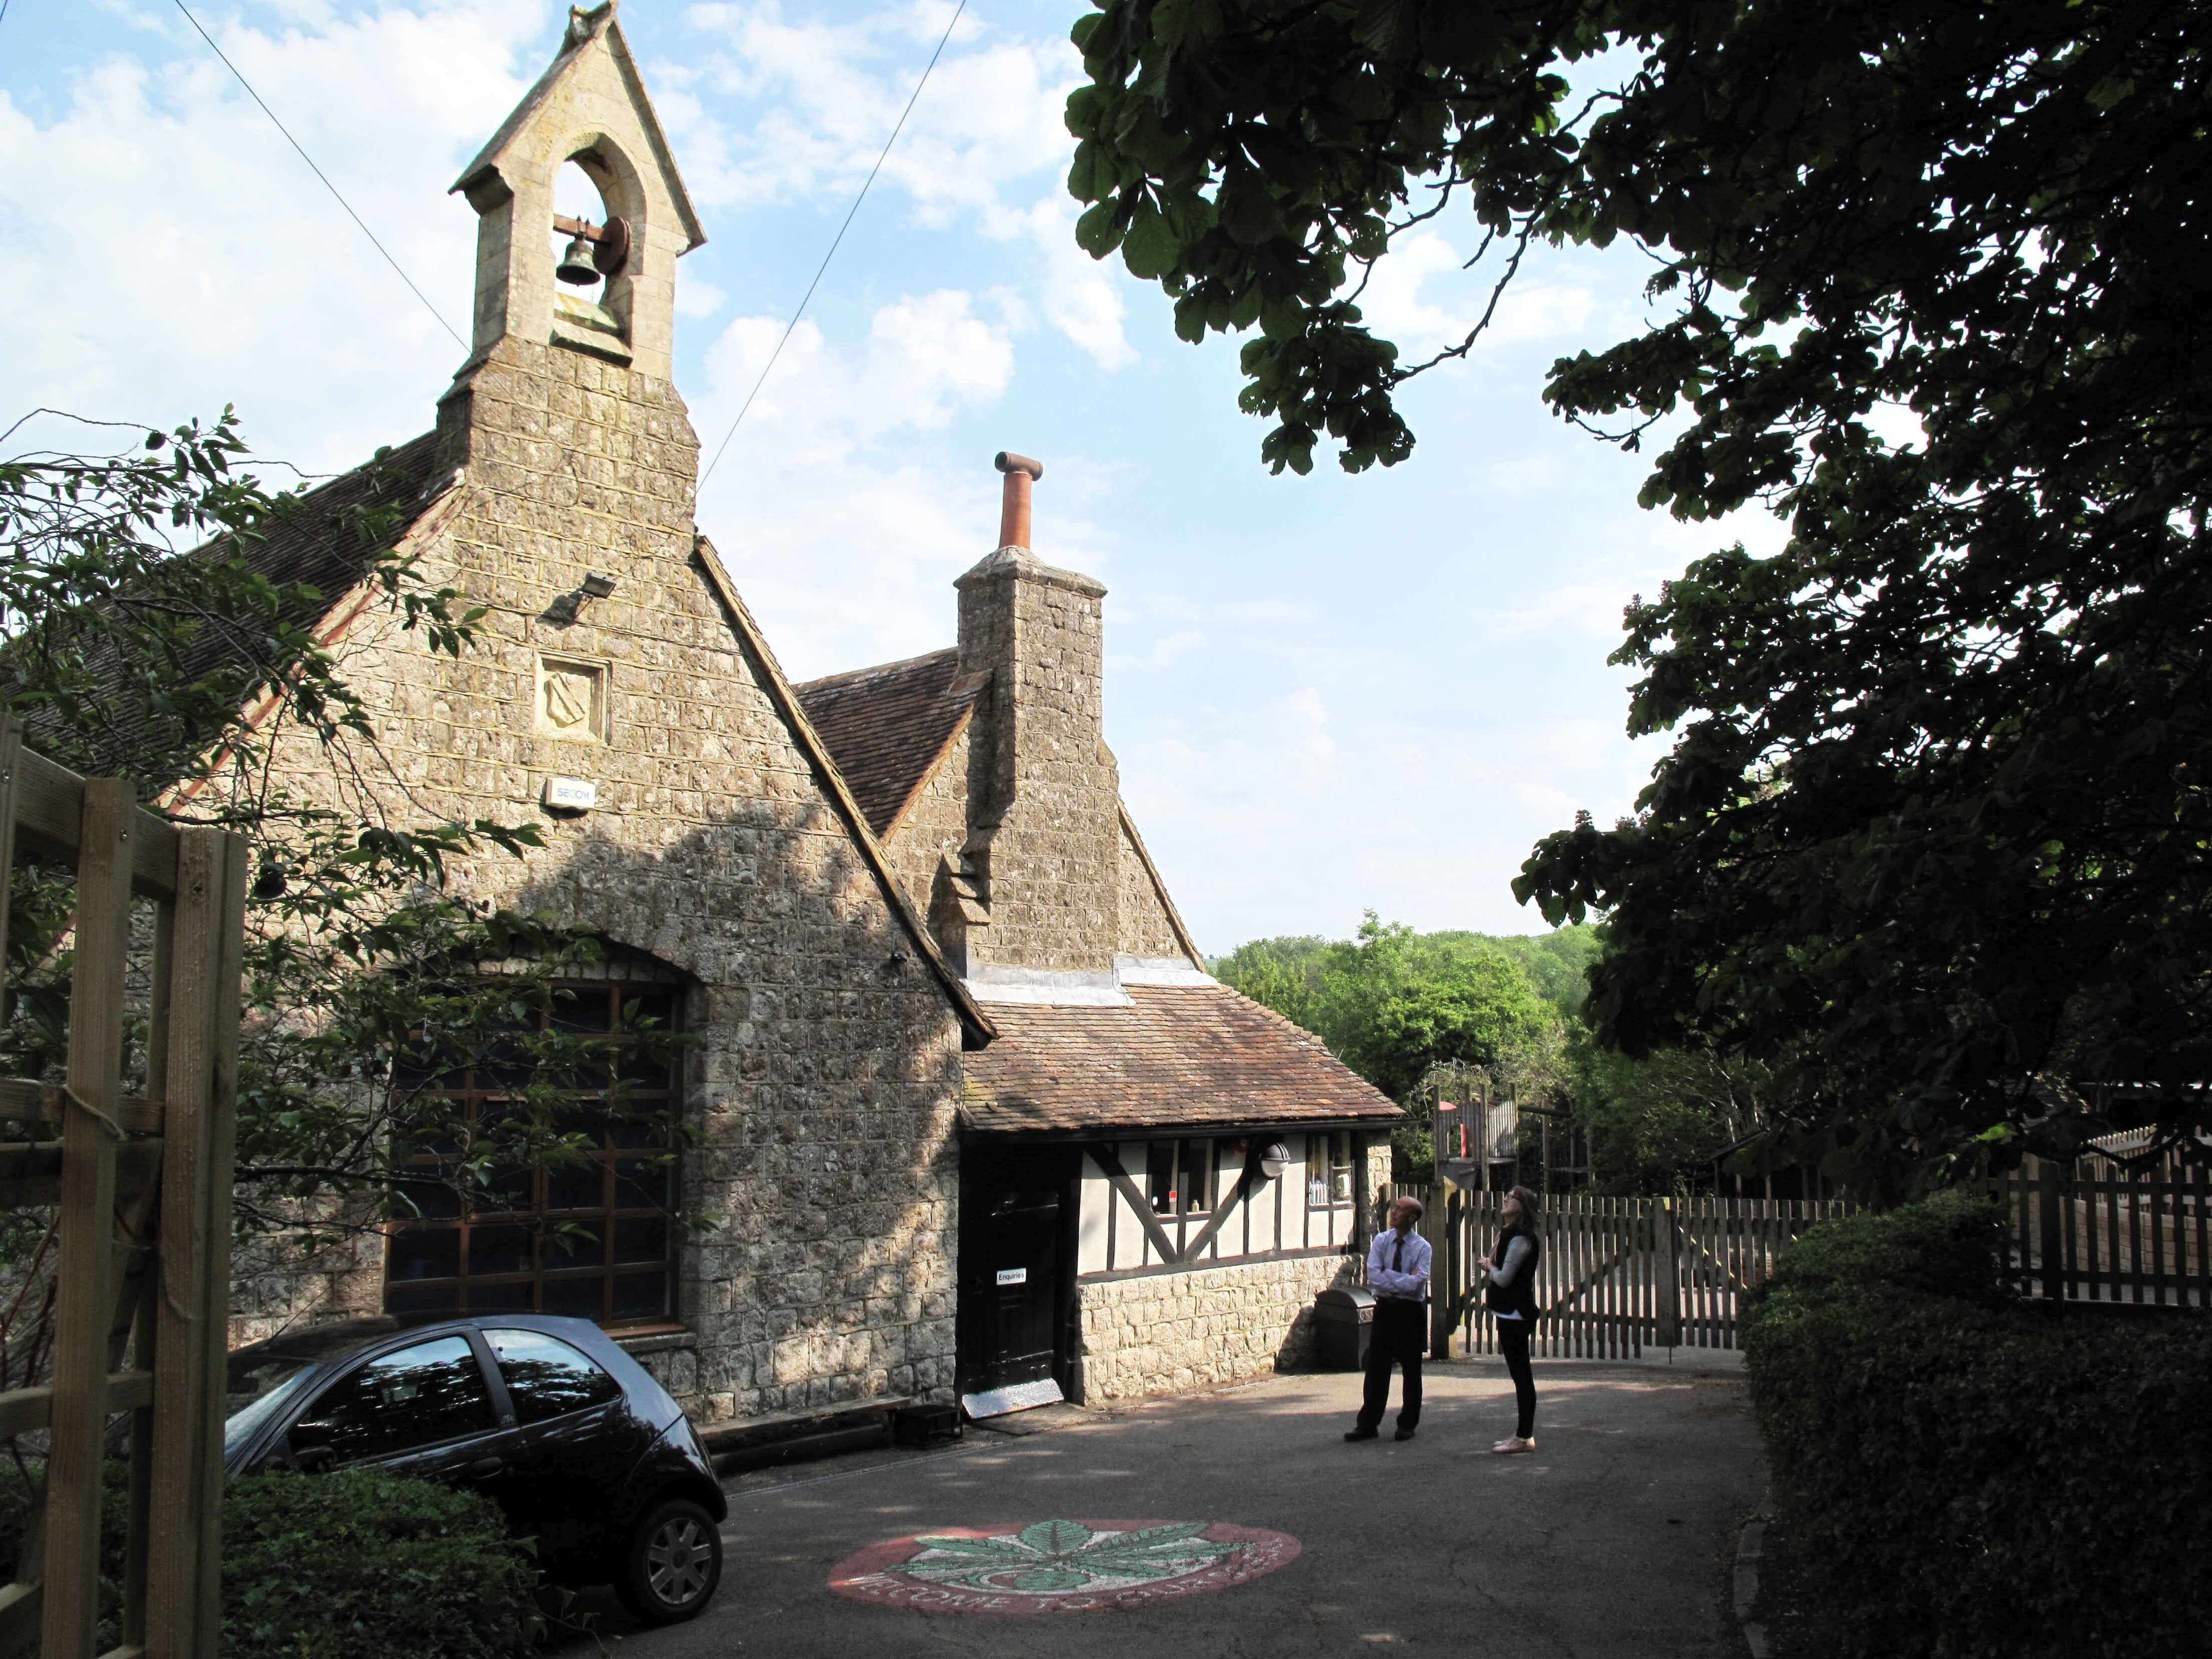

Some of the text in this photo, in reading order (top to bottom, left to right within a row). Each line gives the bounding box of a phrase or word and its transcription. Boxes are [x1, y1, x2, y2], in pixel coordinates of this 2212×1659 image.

[557, 788, 590, 800] SECOM
[998, 1272, 1024, 1281] Enquiries
[845, 1572, 1010, 1607] WELCOME
[1033, 1597, 1096, 1608] TO
